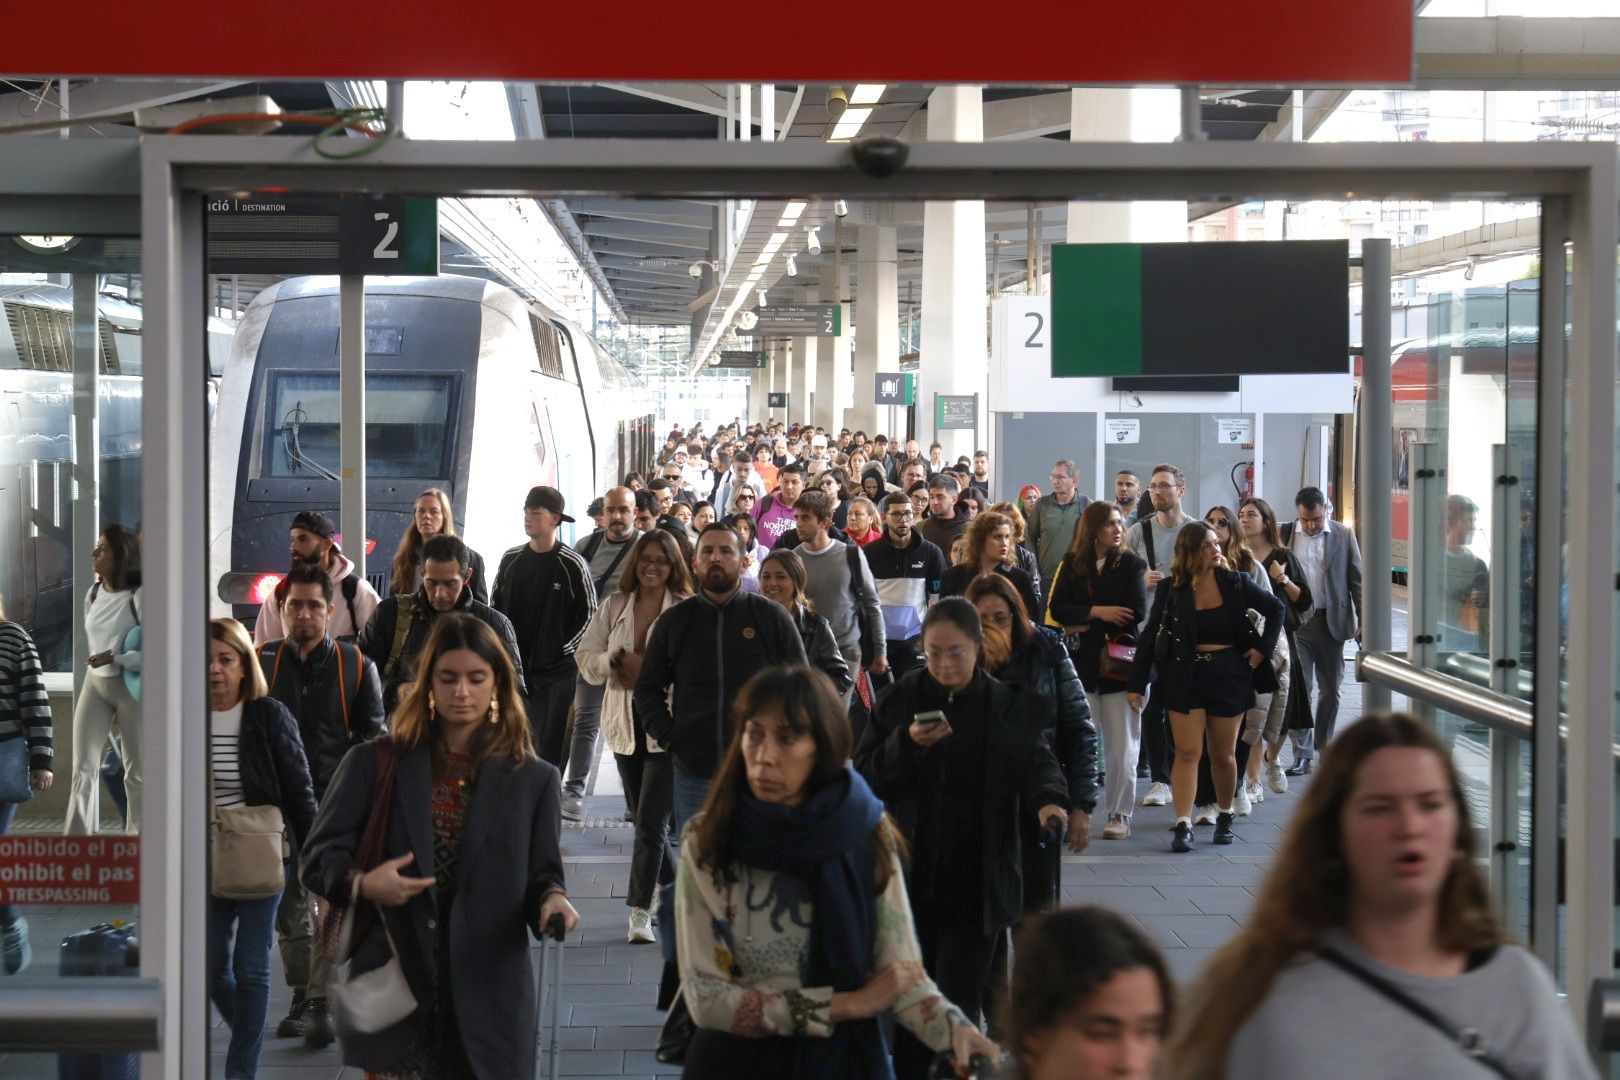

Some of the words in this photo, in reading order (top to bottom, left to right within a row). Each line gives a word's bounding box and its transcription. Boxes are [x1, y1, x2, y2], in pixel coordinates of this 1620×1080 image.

[373, 212, 399, 258] 2
[825, 320, 833, 333] 2
[1024, 311, 1044, 348] 2
[770, 529, 783, 537] FAC
[87, 839, 105, 856] el
[72, 863, 91, 881] el
[98, 866, 134, 885] pas
[7, 887, 110, 902] TRESPASSING
